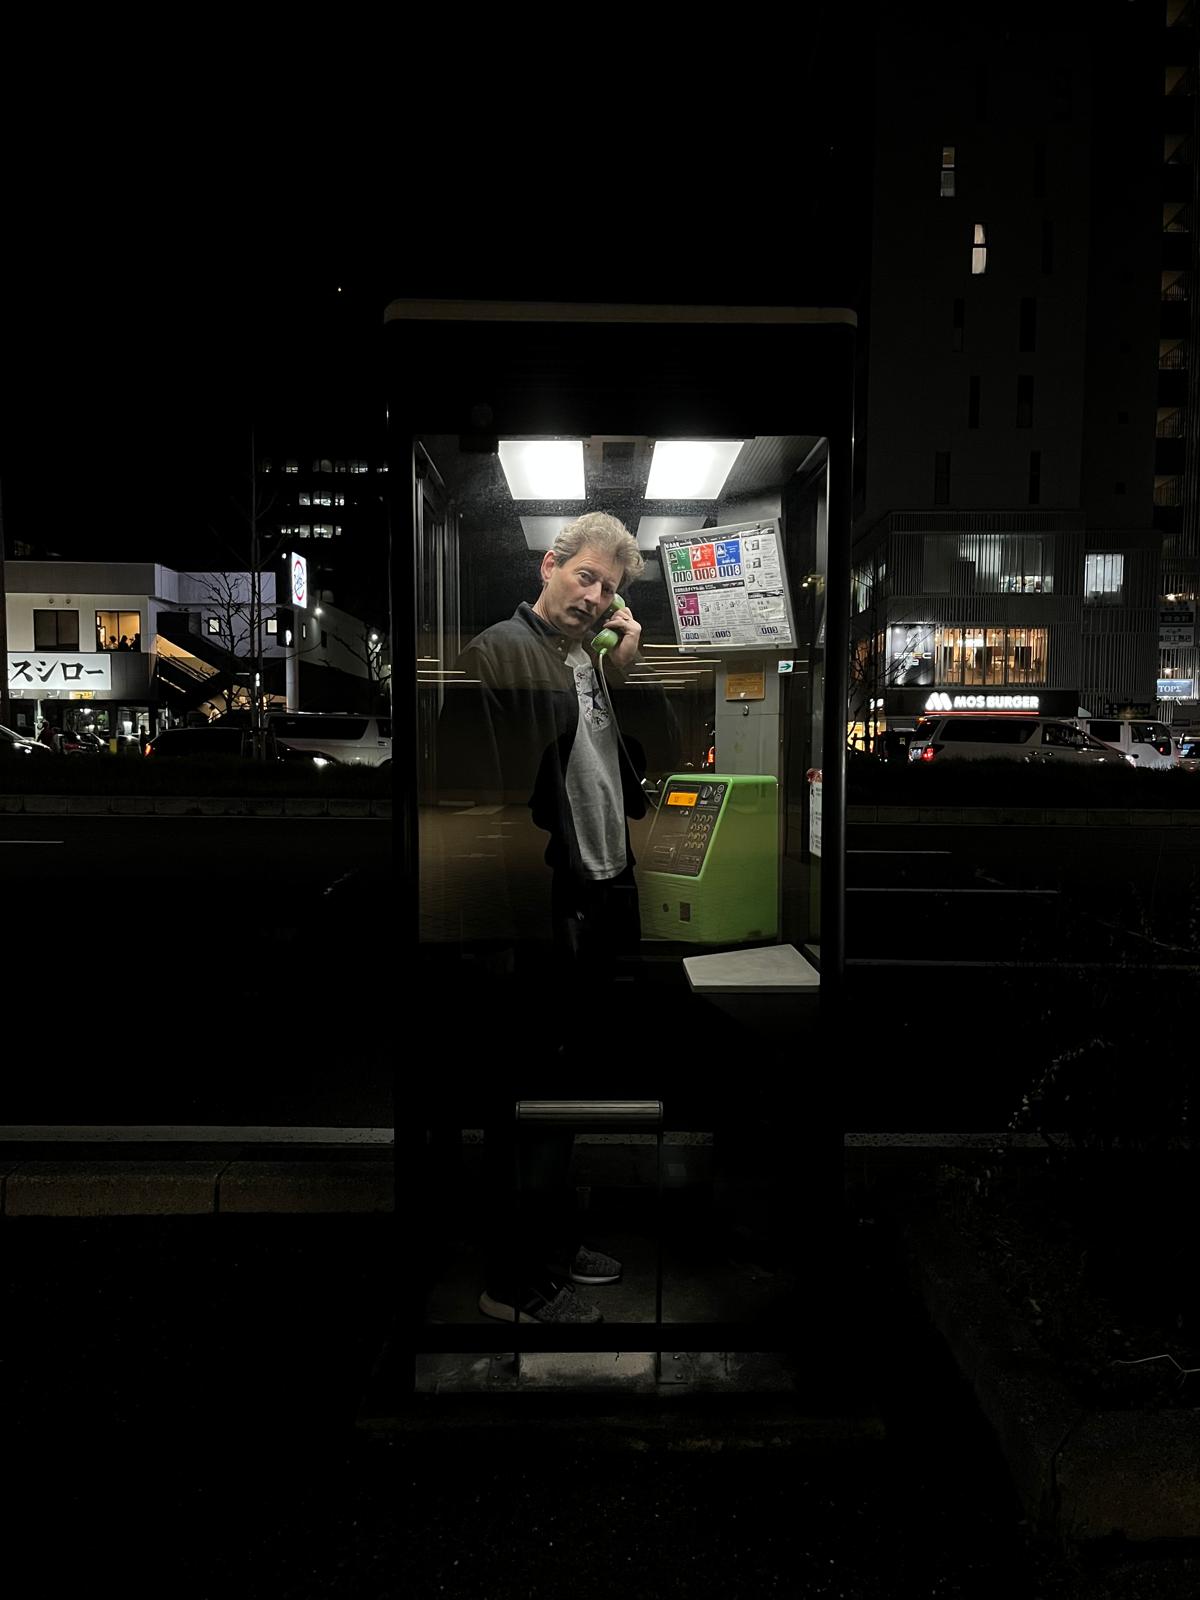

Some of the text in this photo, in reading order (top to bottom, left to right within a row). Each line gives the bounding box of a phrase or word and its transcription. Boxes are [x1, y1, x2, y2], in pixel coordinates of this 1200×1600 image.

[673, 570, 693, 582] 110
[695, 567, 717, 580] 119
[719, 564, 741, 577] 118
[680, 616, 700, 626] 171
[894, 652, 932, 660] SPEC
[10, 660, 104, 683] スシロー
[954, 695, 985, 708] MOS
[986, 695, 1039, 708] BURGER
